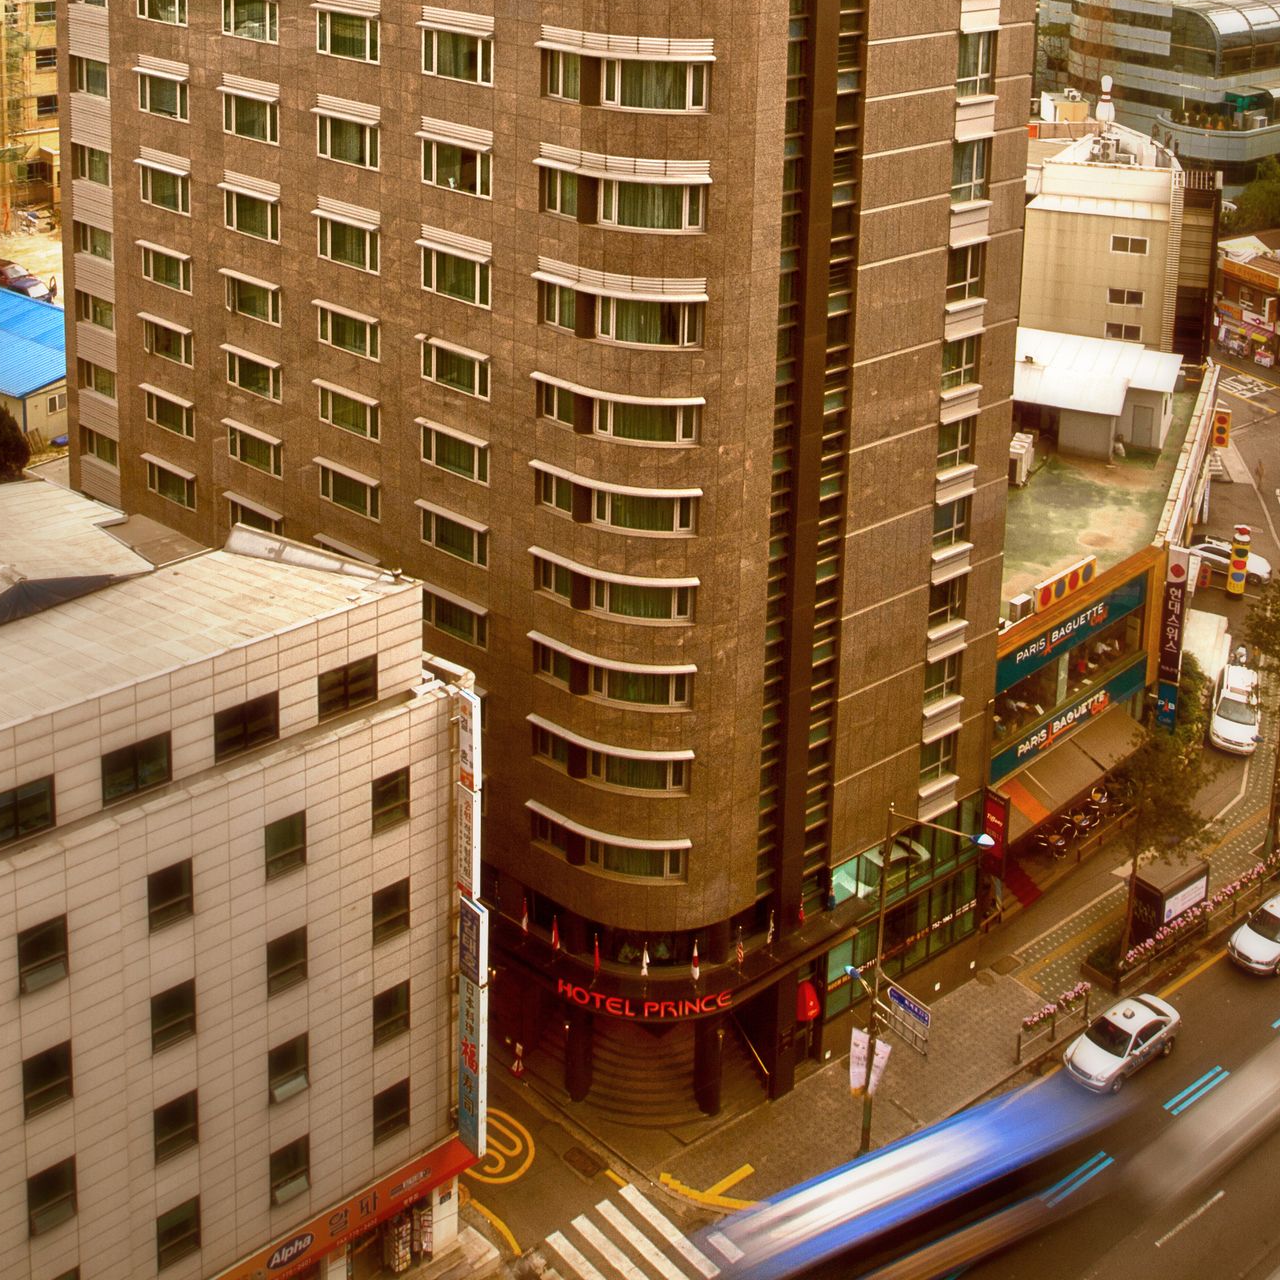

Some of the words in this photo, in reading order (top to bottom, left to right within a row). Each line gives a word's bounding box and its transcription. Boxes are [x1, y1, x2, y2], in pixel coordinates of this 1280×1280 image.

[1016, 638, 1046, 665] PARIS
[1051, 602, 1105, 644] BAGUETTE
[1163, 587, 1182, 654] 현대스위스
[1017, 728, 1048, 759] PARIS
[1052, 689, 1106, 735] BAGUETTE
[465, 981, 475, 1038] 日本料理
[558, 978, 636, 1017] HOTEL
[644, 988, 733, 1018] PRINCE
[270, 1232, 313, 1268] Alpha
